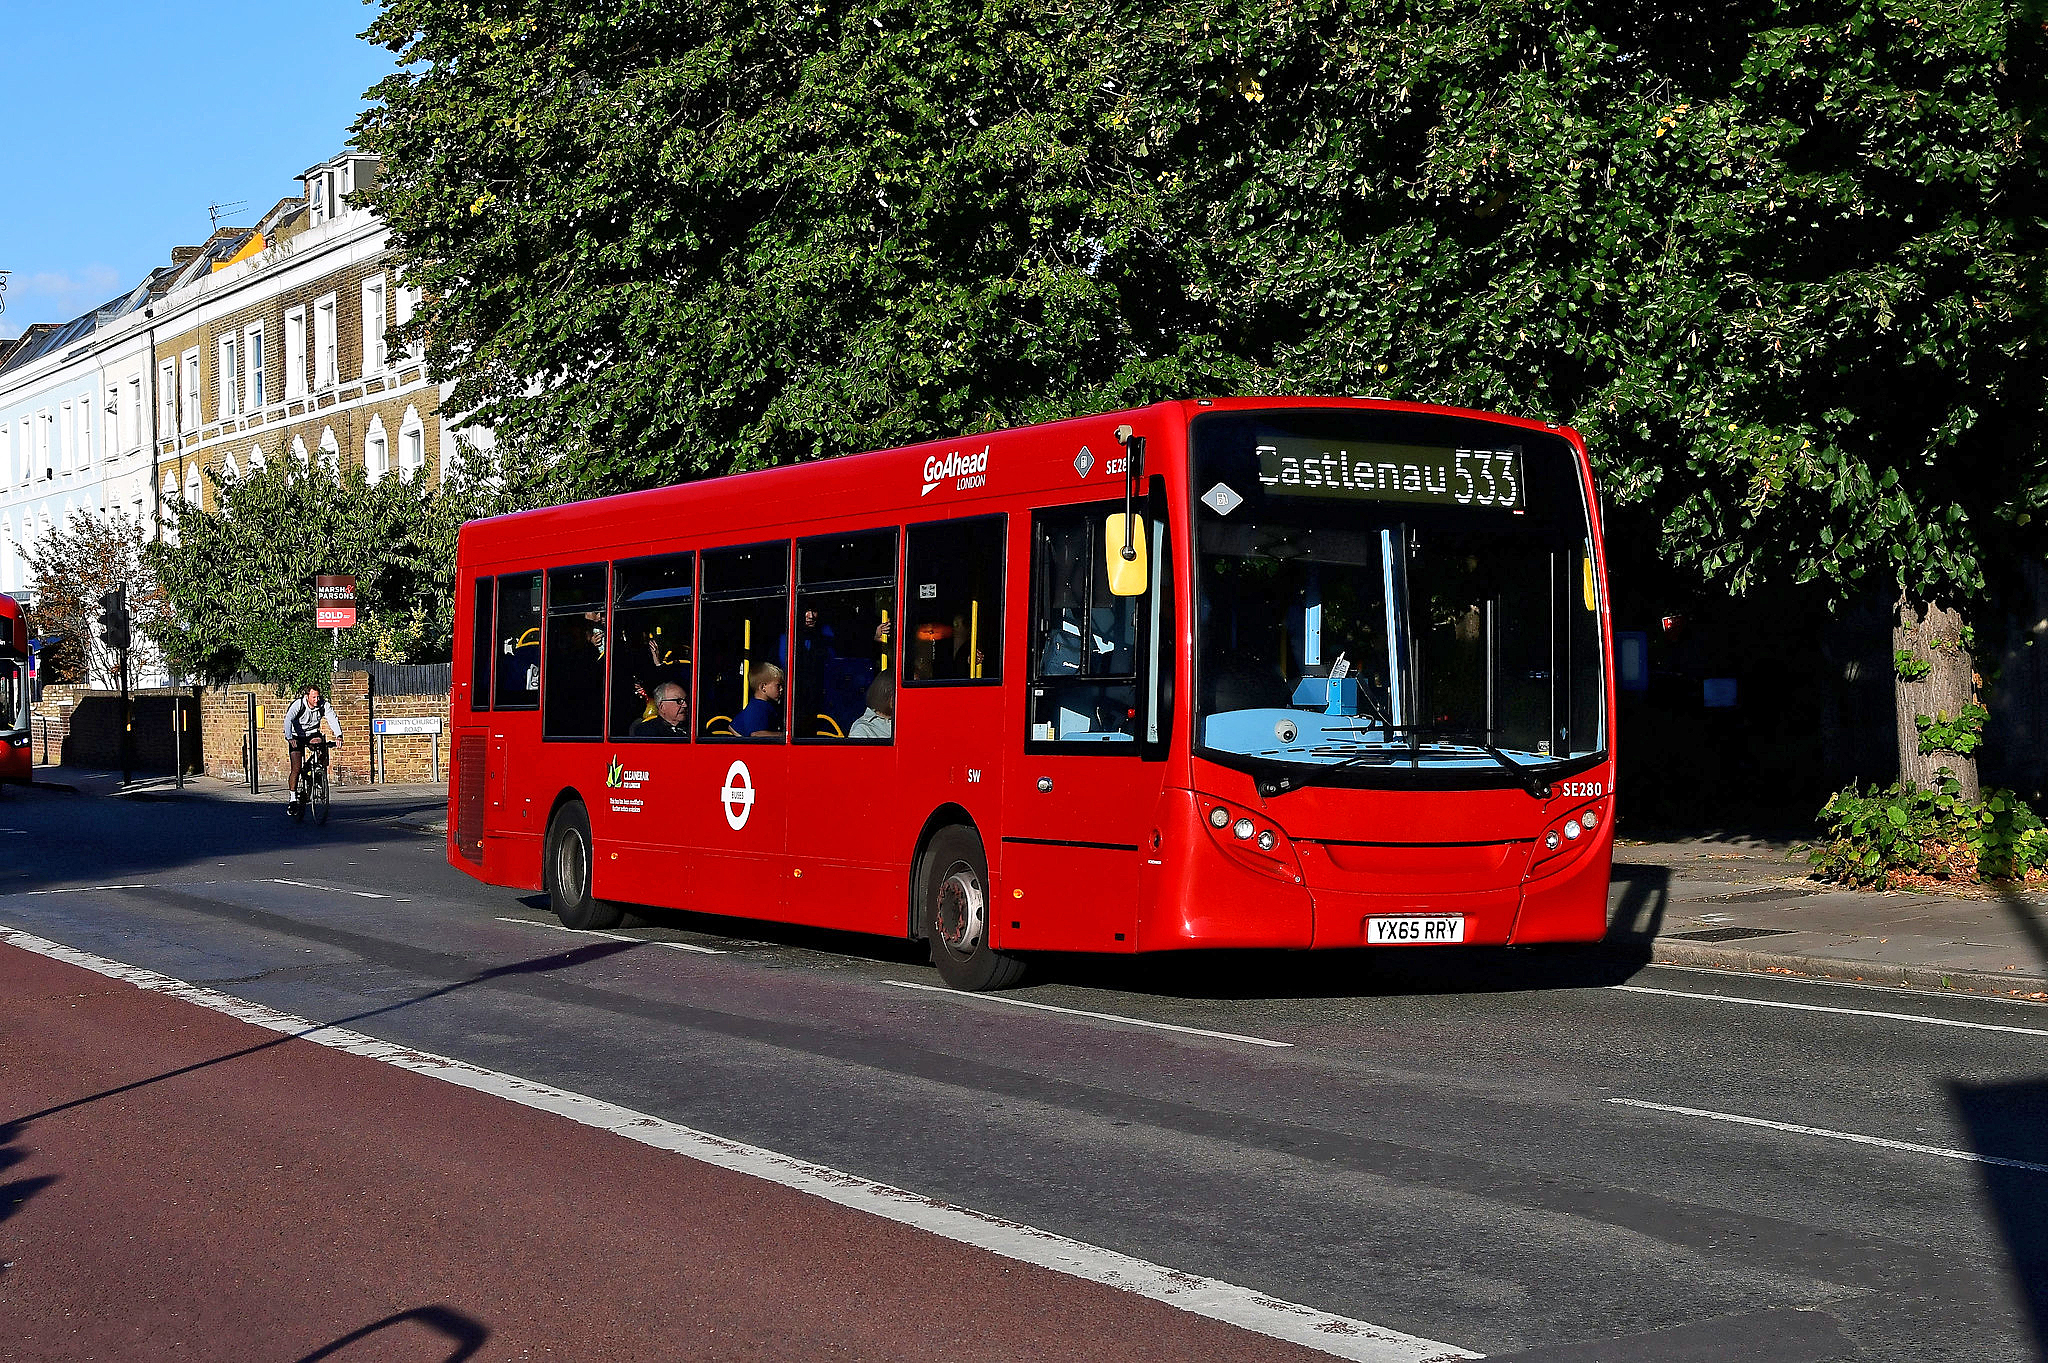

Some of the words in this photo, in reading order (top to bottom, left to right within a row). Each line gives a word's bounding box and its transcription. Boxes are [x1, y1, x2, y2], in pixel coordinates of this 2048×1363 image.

[924, 445, 990, 482] GoAhead
[1106, 457, 1127, 475] SE28
[956, 474, 986, 491] LONDON
[1256, 445, 1447, 495] Castlenau
[1454, 449, 1517, 506] 533
[319, 611, 343, 619] SOLD
[968, 769, 981, 783] SW
[731, 791, 744, 800] BUSES
[1562, 782, 1602, 797] SE280
[1377, 921, 1420, 940] YX65
[1425, 920, 1457, 939] RRY
